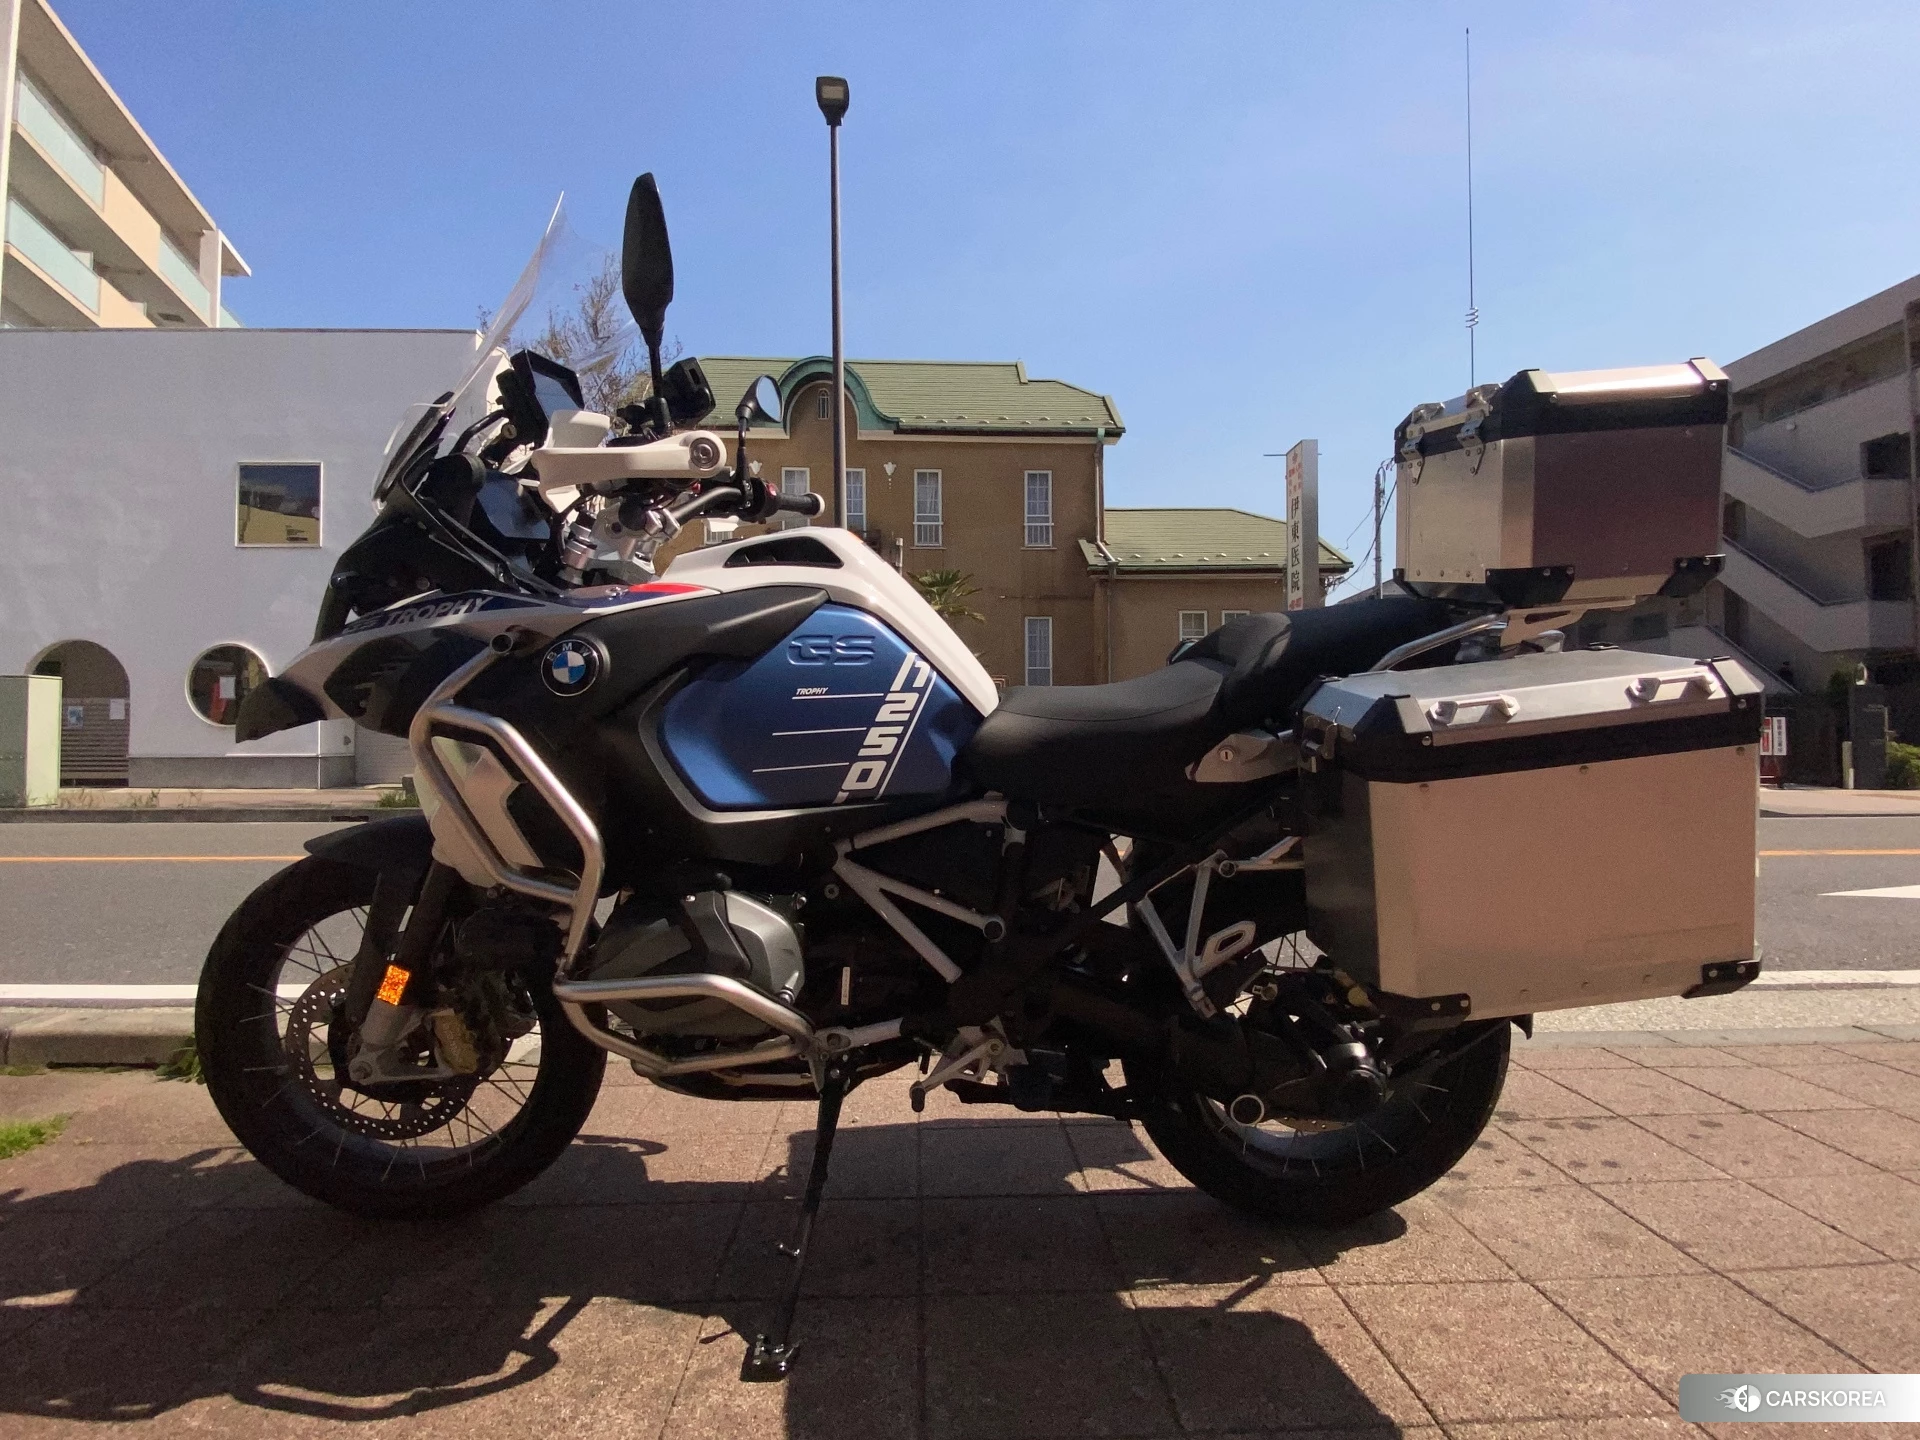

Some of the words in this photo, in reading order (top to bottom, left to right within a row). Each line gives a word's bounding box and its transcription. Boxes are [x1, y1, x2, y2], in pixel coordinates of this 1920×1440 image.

[1290, 495, 1301, 594] 伊東医院
[385, 596, 494, 626] TROPHY
[547, 642, 591, 661] BMW
[786, 634, 876, 665] GS
[796, 687, 829, 696] TROPHY
[841, 660, 931, 790] 1250
